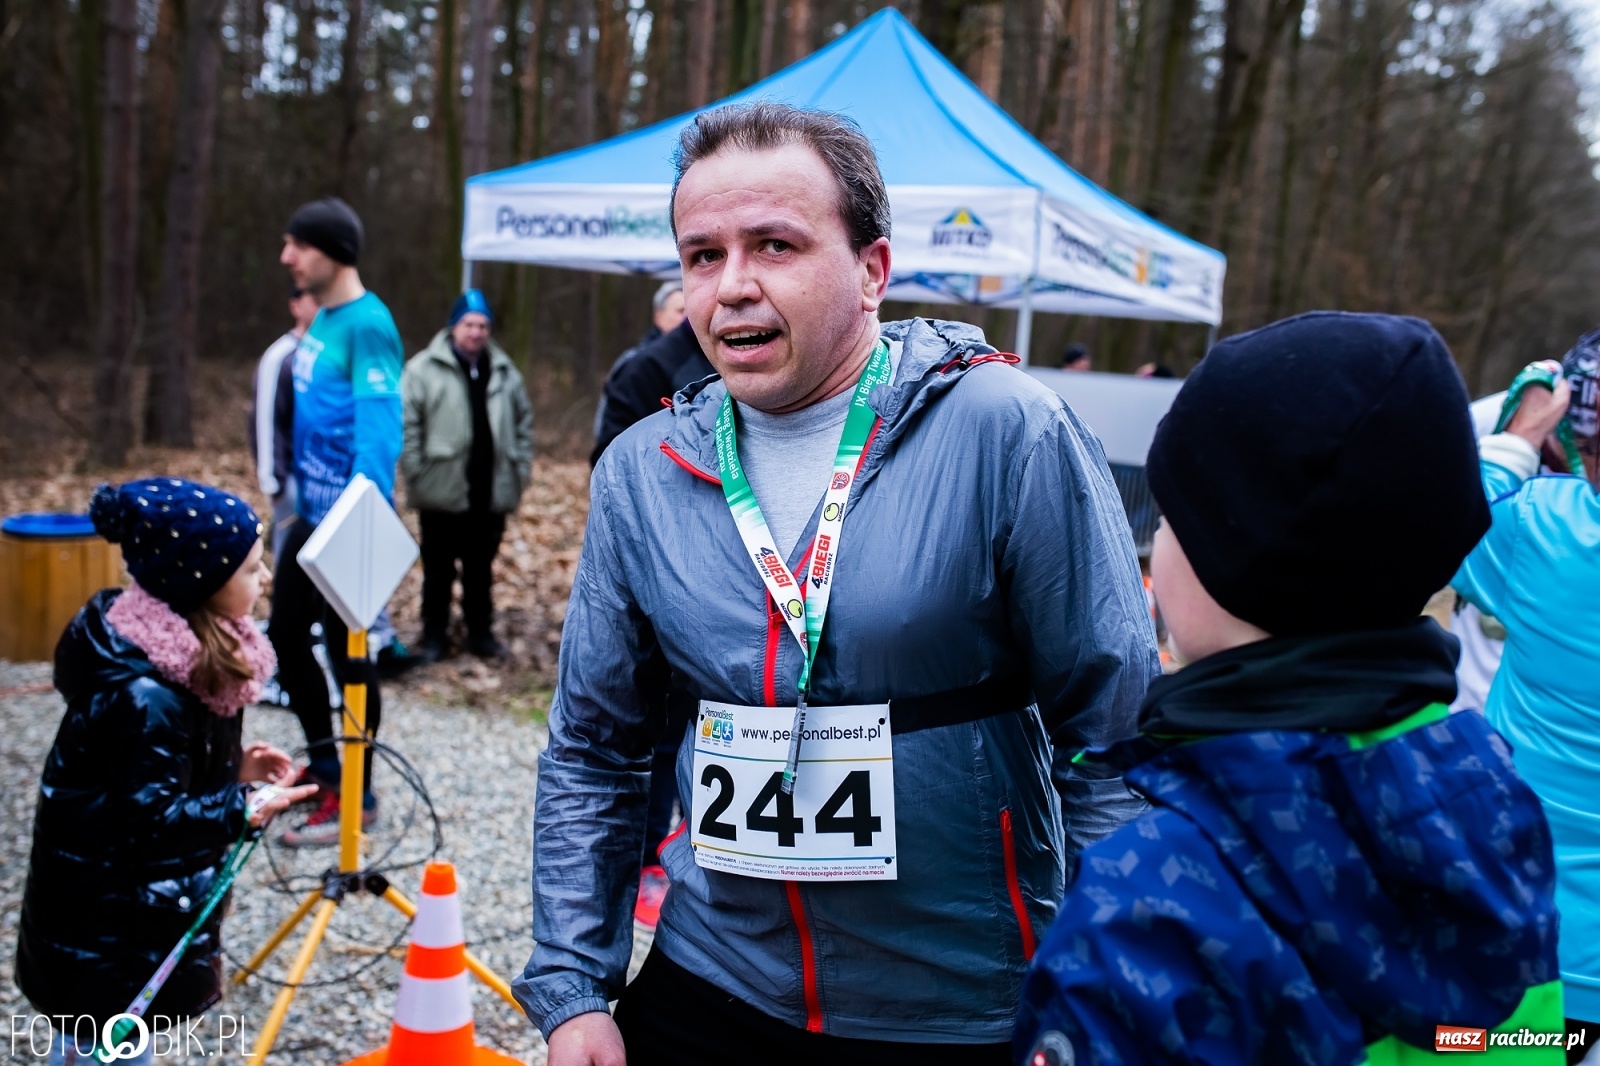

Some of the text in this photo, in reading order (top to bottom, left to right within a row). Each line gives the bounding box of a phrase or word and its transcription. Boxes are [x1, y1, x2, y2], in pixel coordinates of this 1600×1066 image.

[859, 373, 877, 395] Bieg
[854, 395, 867, 407] IX
[722, 407, 732, 431] Bieg
[715, 426, 726, 473] Raciborzu
[725, 428, 740, 480] Twardziela
[741, 725, 881, 743] www.peonalbest.pl
[698, 763, 882, 848] 244
